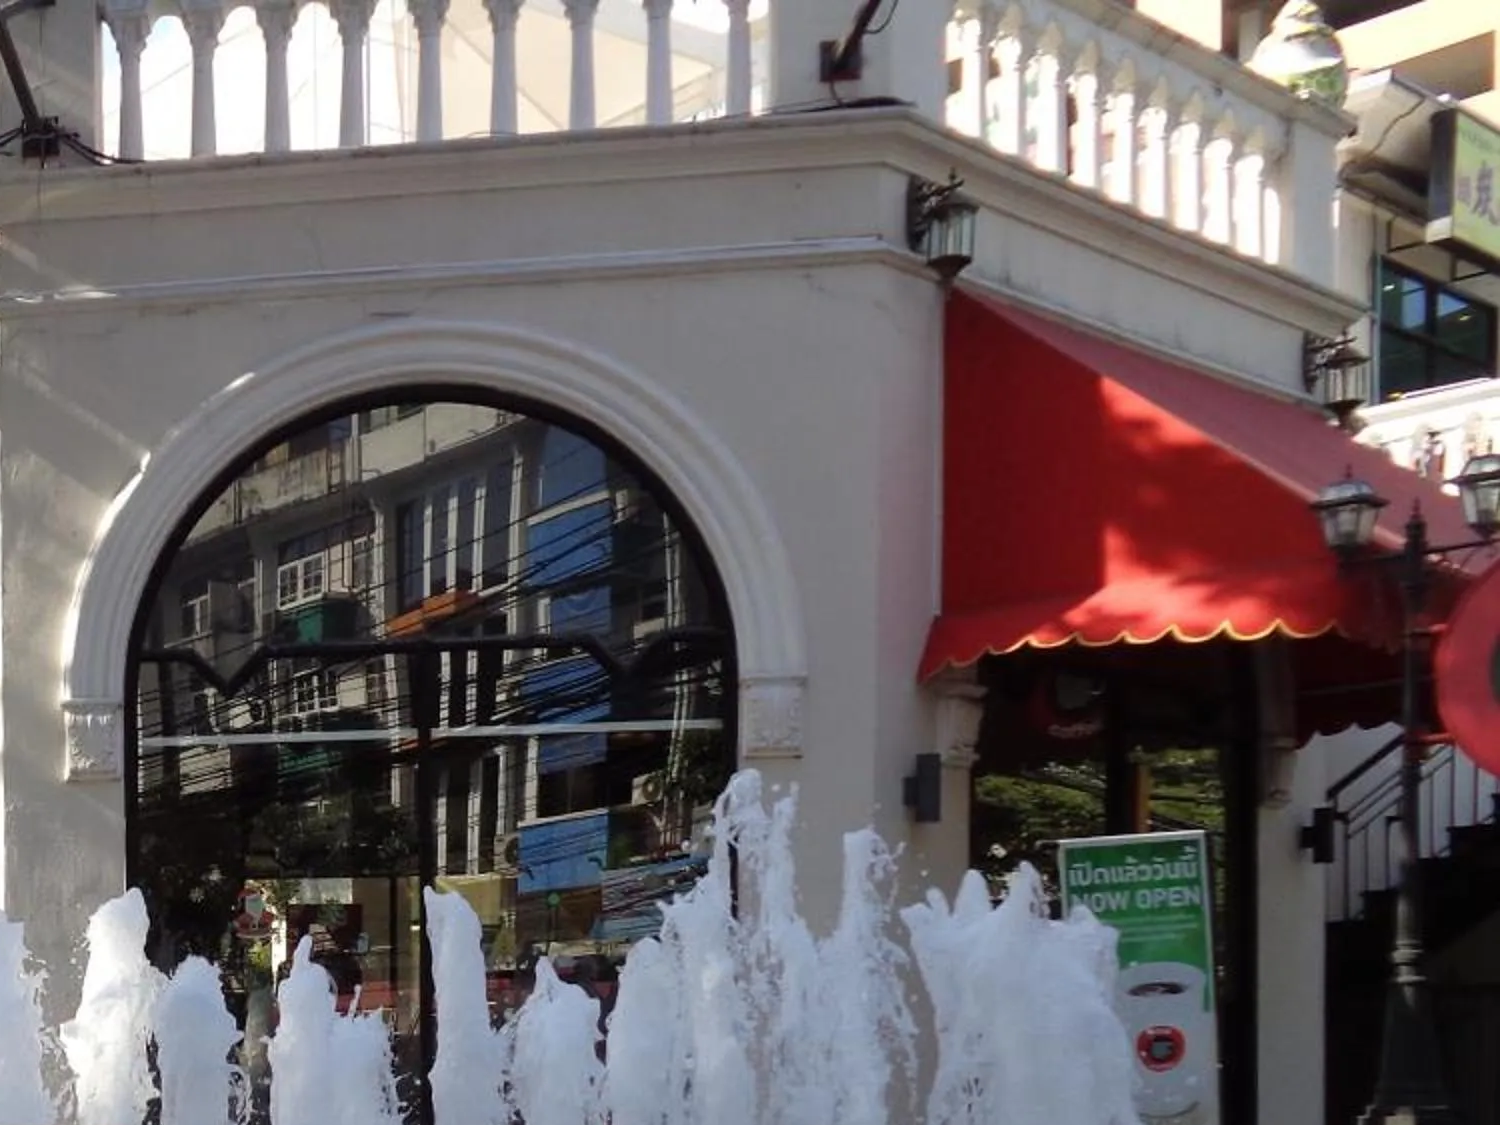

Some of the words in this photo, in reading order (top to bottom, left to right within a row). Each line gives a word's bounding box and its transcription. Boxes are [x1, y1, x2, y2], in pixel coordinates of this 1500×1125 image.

[1069, 846, 1197, 887] เปิดแล้ววันนี้
[1071, 892, 1129, 913] NOW
[1135, 886, 1201, 909] OPEN
